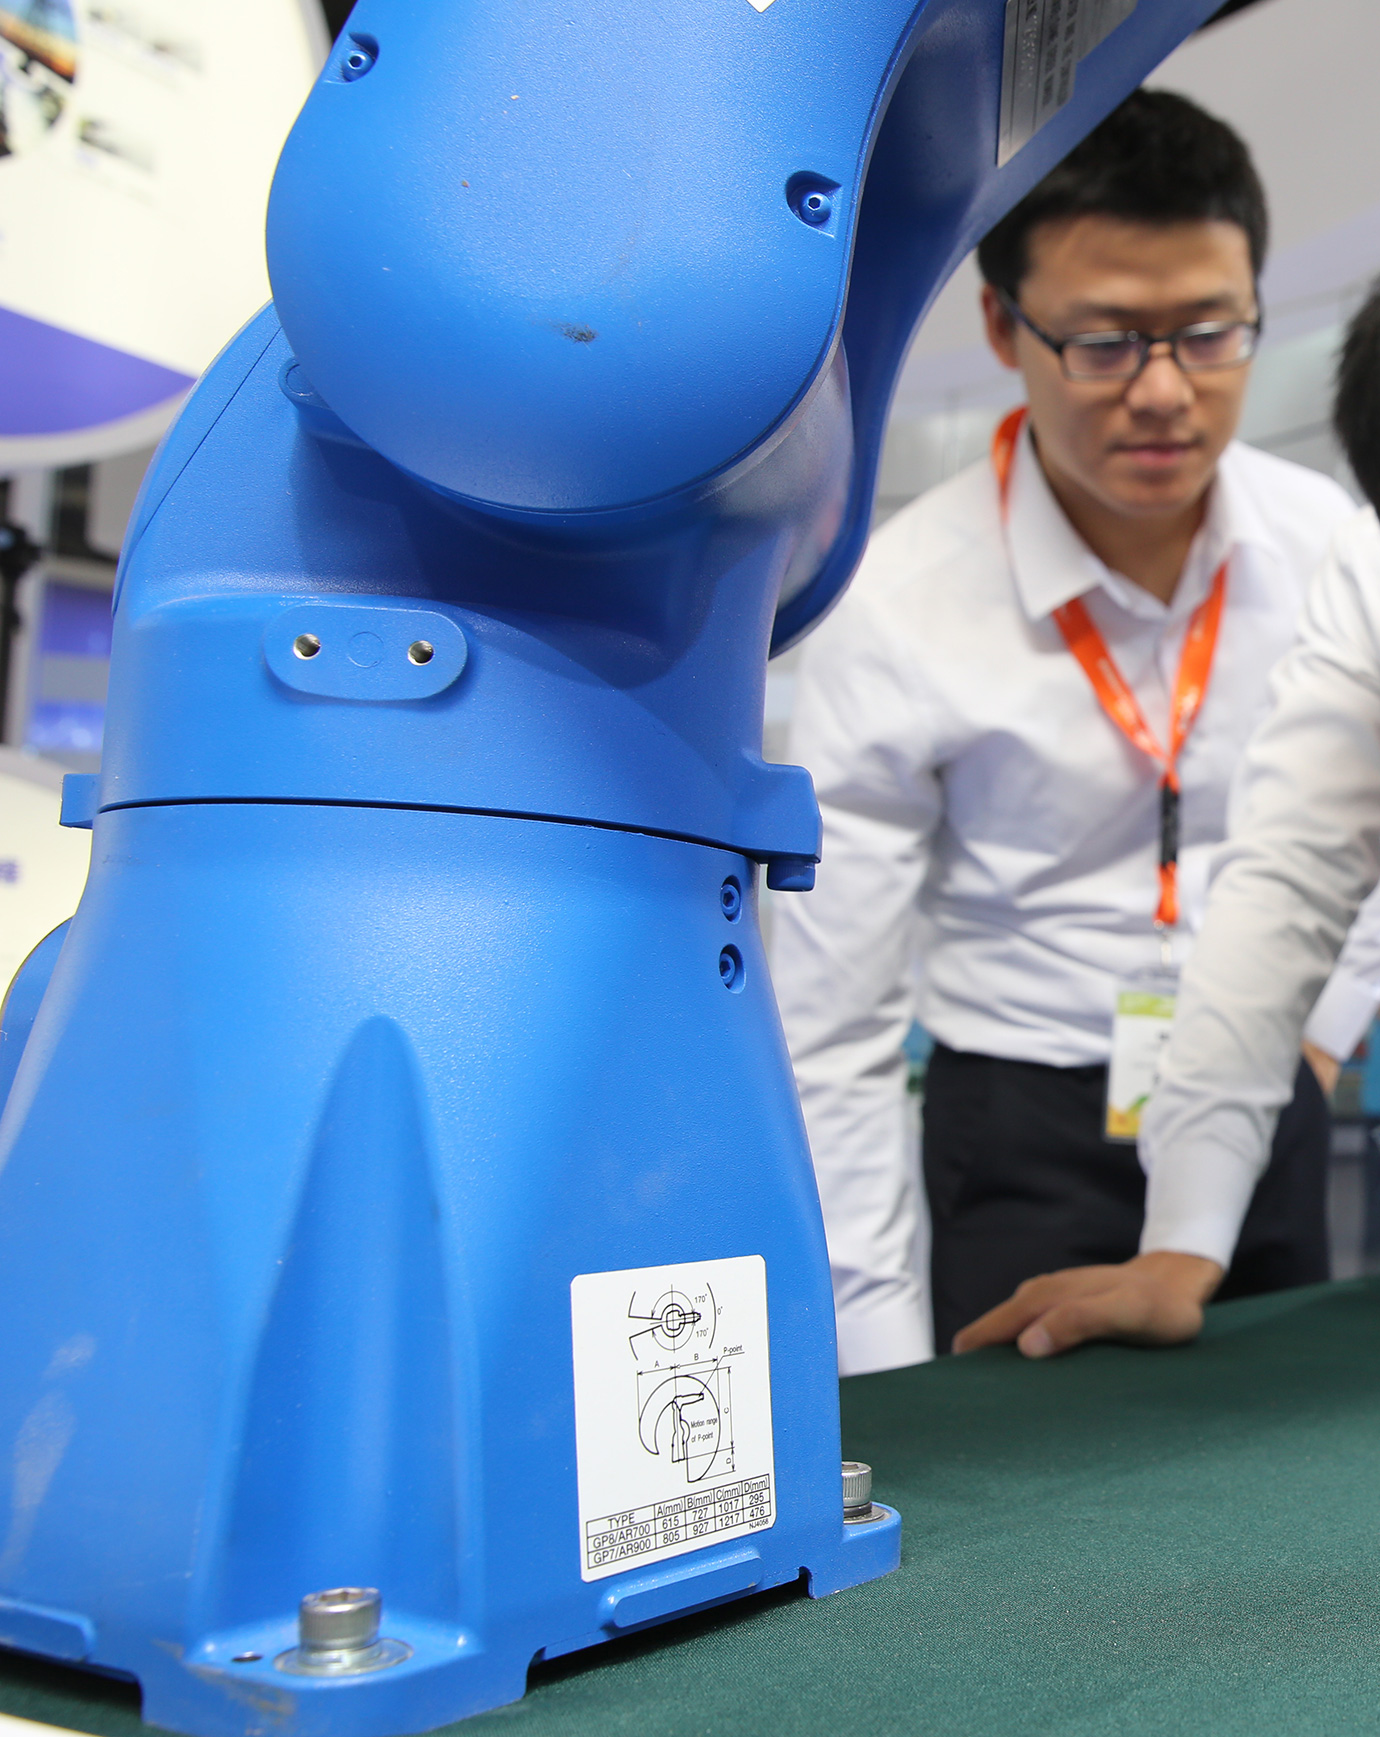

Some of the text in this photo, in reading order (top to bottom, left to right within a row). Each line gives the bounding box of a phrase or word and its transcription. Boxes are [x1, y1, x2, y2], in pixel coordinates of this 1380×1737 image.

[723, 1344, 744, 1355] P-point
[694, 1353, 700, 1361] B
[654, 1360, 660, 1369] A
[690, 1417, 718, 1429] Motion range
[691, 1431, 714, 1443] of P-point
[725, 1457, 732, 1465] D
[607, 1477, 768, 1530] TYPE A(mm) B(mm) C(mm) D(mm)
[592, 1491, 765, 1550] GP8/AR700 615 727 1017 295
[593, 1505, 766, 1565] GP7/AR900 805 927 1217 476
